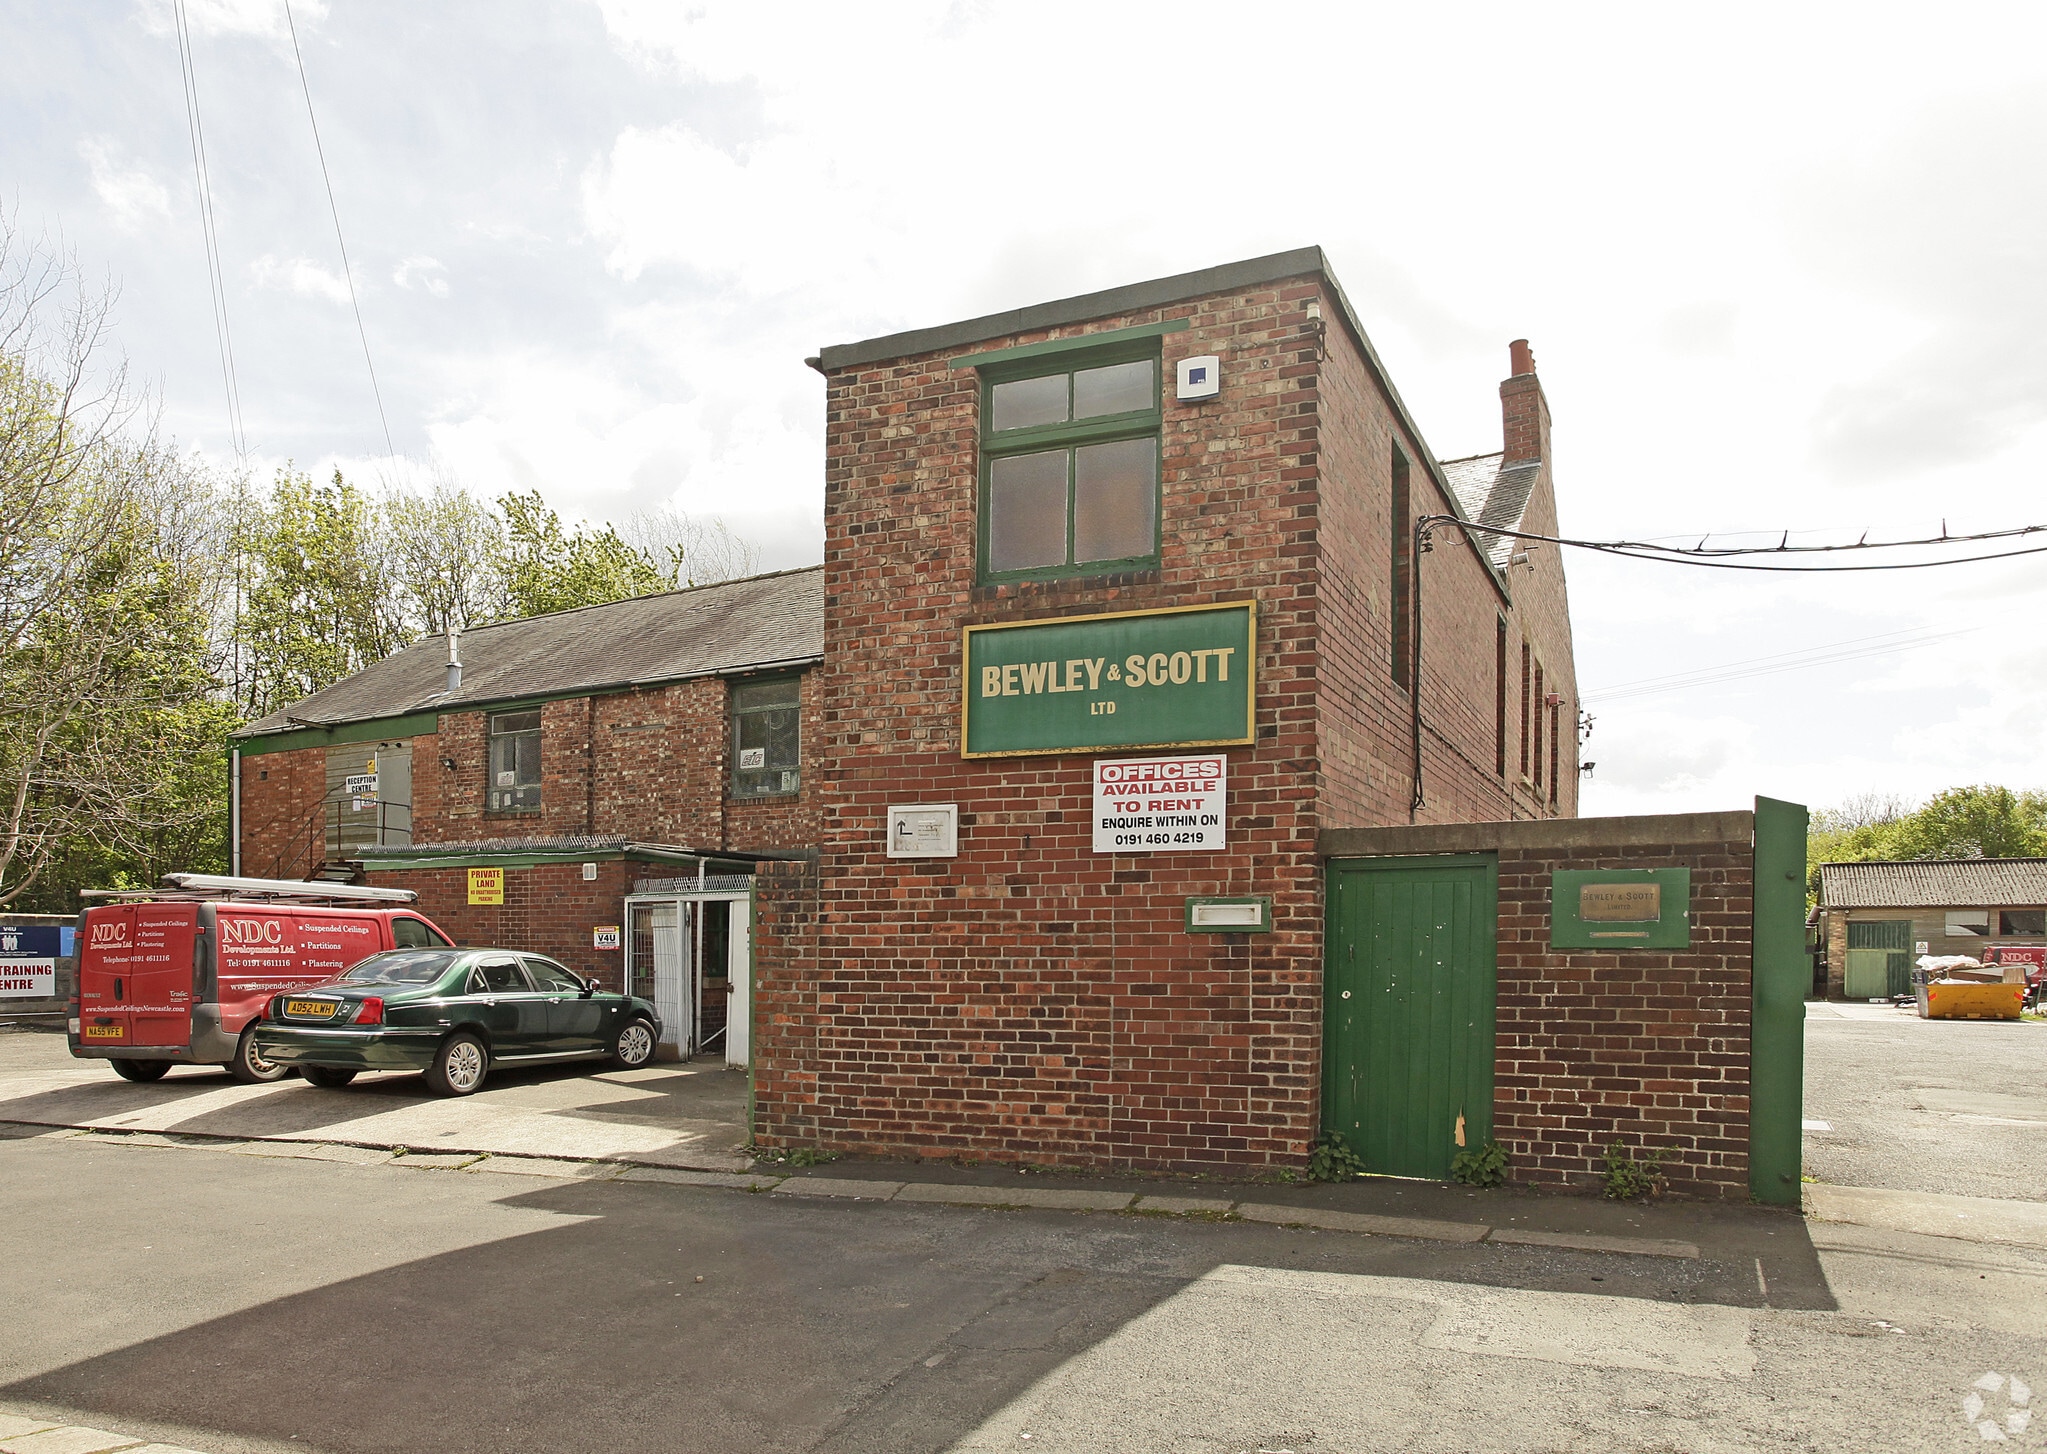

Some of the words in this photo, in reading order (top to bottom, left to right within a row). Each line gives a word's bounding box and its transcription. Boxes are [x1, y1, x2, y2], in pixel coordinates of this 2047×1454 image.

[981, 657, 1105, 698] BEWLEY
[1107, 663, 1121, 681] &
[1125, 647, 1235, 688] SCOTT
[1090, 701, 1116, 715] LTD
[1102, 762, 1219, 781] OFFICES
[347, 776, 377, 785] RECEPTION
[351, 785, 372, 793] CENTRE
[1102, 781, 1216, 796] AVAILABLE
[1113, 801, 1140, 812] TO
[1148, 799, 1205, 811] RENT
[1102, 817, 1152, 829] ENQUIRE
[1156, 815, 1197, 827] WITHIN
[1200, 814, 1218, 826] ON
[1115, 834, 1142, 845] 0191
[1146, 833, 1170, 844] 460
[1174, 832, 1204, 843] 4219
[471, 870, 501, 878] PRIVATE
[476, 880, 495, 888] LAND
[1583, 893, 1615, 901] BEWLEY
[1626, 892, 1655, 900] SCOTT
[91, 922, 126, 942] NDC
[220, 919, 282, 944] NDC
[304, 923, 342, 933] Suspended
[343, 925, 370, 934] Ceilings
[597, 934, 616, 942] V4U
[222, 944, 279, 955] Developments
[280, 944, 296, 953] Ltd.
[307, 942, 342, 950] Partitions
[130, 955, 144, 963] 0191
[2000, 952, 2032, 962] NDC
[227, 959, 241, 967] Tel:
[308, 960, 344, 969] Plastering
[0, 979, 34, 990] ENTRE
[292, 1003, 313, 1013] AD52
[313, 1004, 331, 1014] LWH
[88, 1027, 106, 1036] NA55
[107, 1027, 120, 1036] VFE
